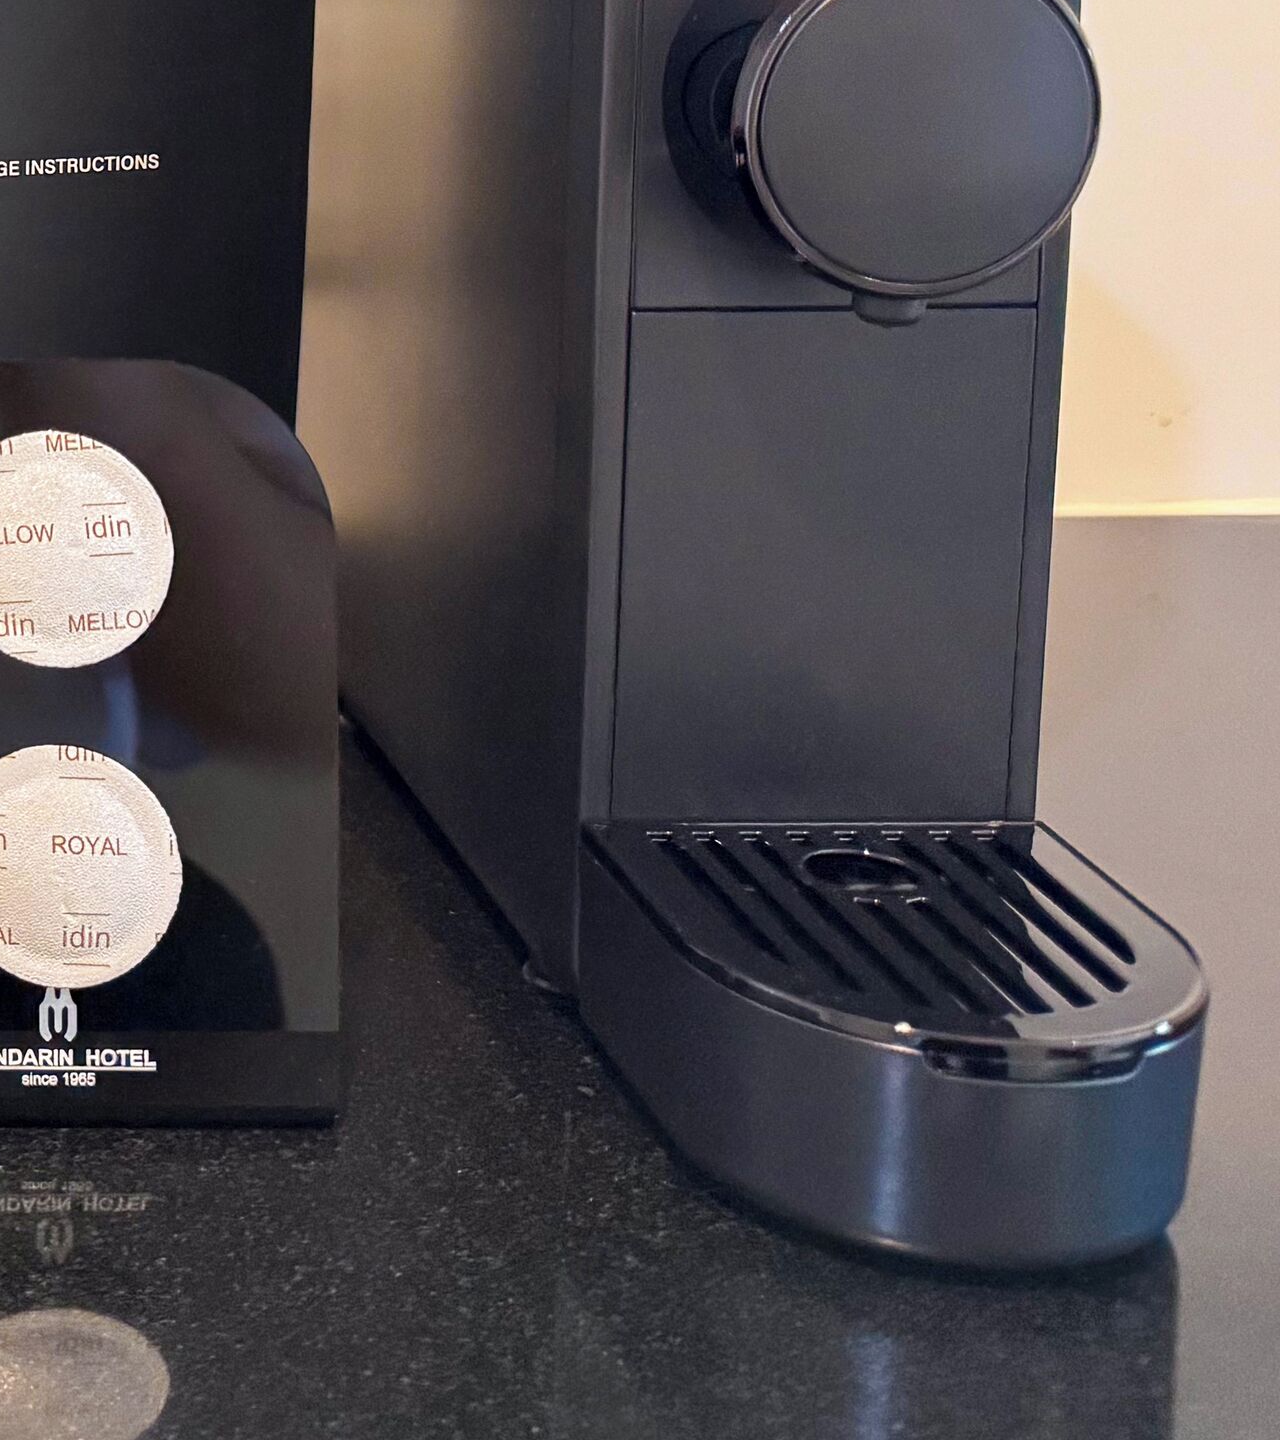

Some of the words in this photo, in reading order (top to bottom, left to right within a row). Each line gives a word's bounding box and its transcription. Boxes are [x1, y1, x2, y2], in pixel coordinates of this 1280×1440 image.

[25, 153, 160, 175] INSTRUCTIONS
[84, 515, 131, 539] idin
[52, 834, 127, 856] ROYAL
[62, 925, 111, 949] idin
[85, 1048, 157, 1067] HOTEL
[21, 1072, 58, 1086] since
[62, 1073, 96, 1086] 1965
